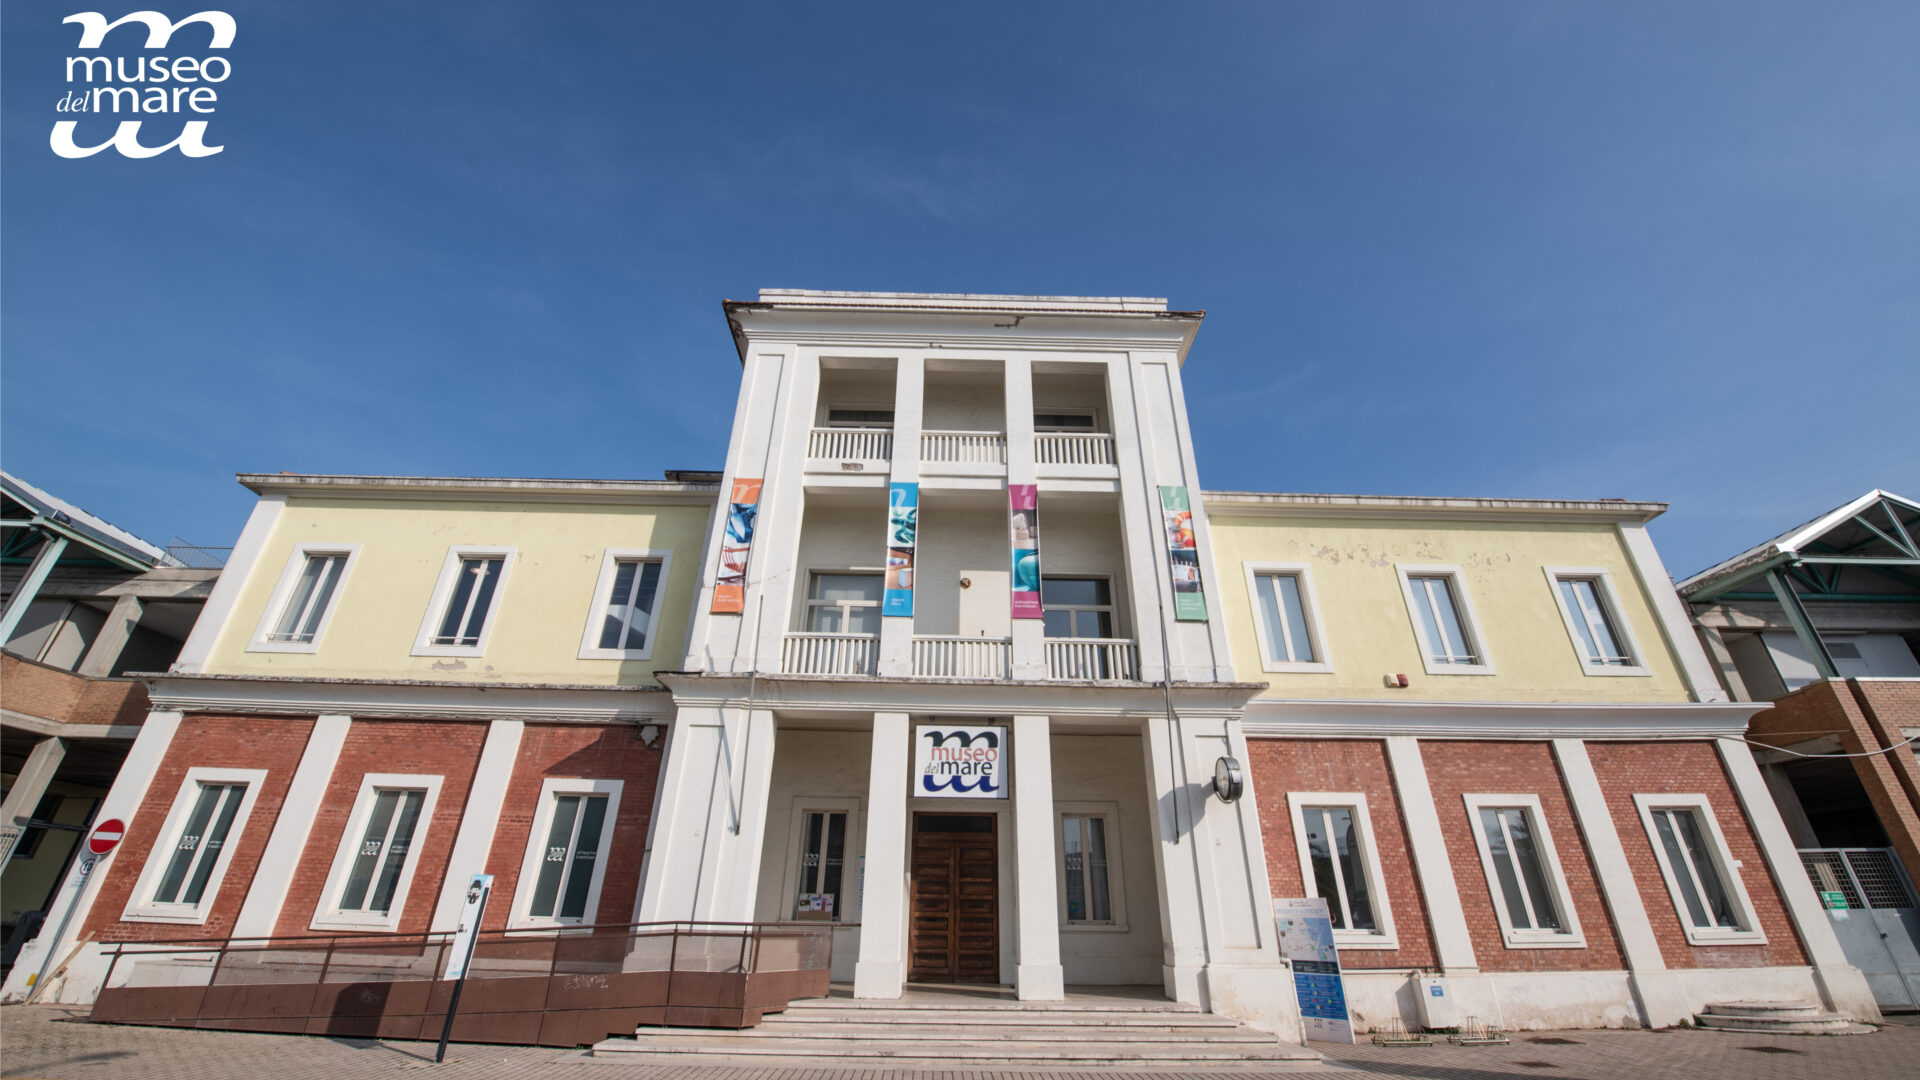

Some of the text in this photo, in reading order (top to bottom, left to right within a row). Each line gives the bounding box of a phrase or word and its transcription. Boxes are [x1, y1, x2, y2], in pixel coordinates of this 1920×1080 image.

[931, 746, 998, 763] museo
[924, 761, 993, 776] del mare
